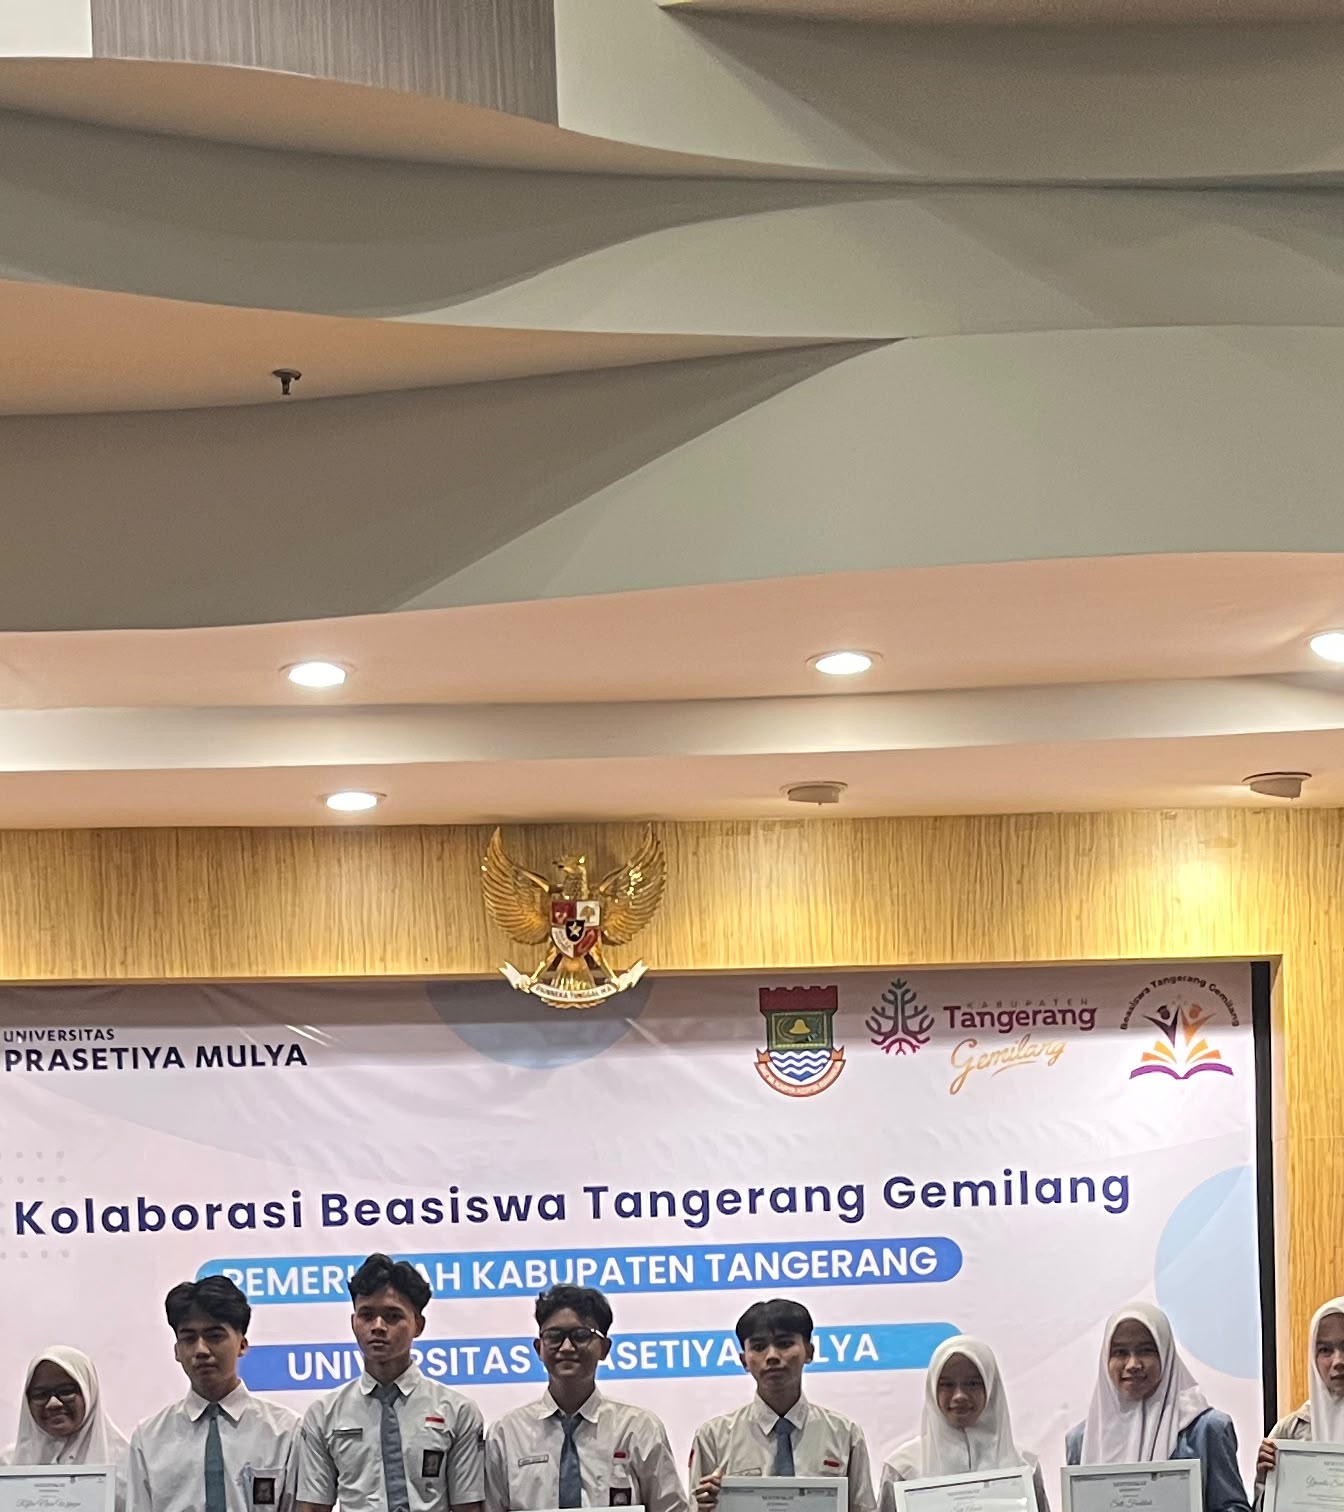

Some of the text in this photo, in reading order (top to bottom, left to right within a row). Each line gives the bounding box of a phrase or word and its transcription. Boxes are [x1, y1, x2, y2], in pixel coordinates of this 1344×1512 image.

[943, 1005, 1098, 1034] Tangerang
[966, 999, 1088, 1009] KABUPATEN
[3, 1028, 115, 1043] UNIVERSITAS
[5, 1043, 308, 1072] PRASETIYA MULYA
[950, 1033, 1067, 1095] Gemilang
[15, 1168, 1129, 1236] Kolaborasi Beasiswa Tangerang Gemilang
[222, 1246, 938, 1297] PEMERIAH KABUPATEN TANGERANG
[288, 1345, 531, 1381] UNISITAS
[812, 1333, 879, 1363] LYA
